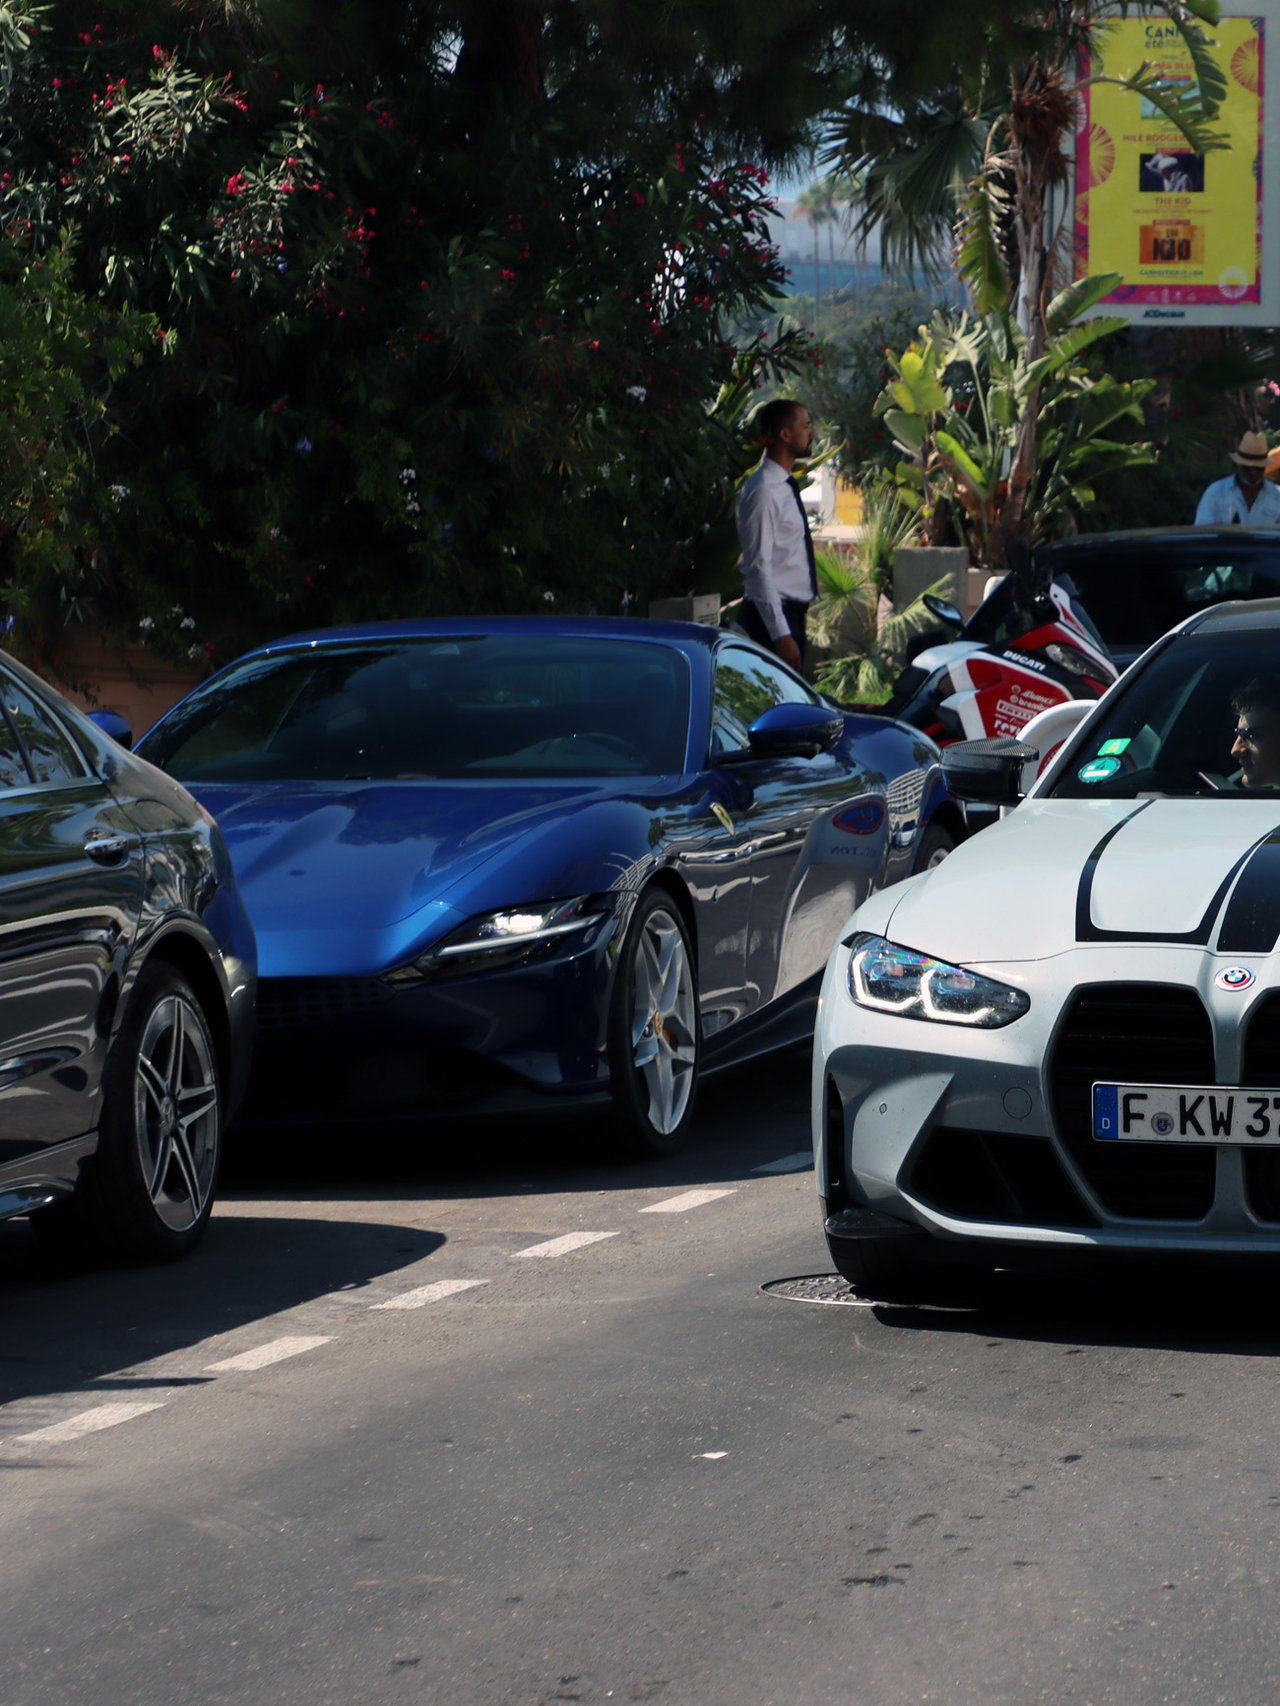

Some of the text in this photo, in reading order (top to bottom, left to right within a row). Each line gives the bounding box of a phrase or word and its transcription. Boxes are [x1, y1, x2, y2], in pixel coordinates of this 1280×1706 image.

[1146, 133, 1187, 142] RODGER
[1155, 197, 1191, 205] THE KID
[1143, 310, 1185, 318] JCDecaux
[1003, 650, 1046, 672] DUCATI
[1122, 1093, 1148, 1133] F
[1179, 1094, 1235, 1136] KW
[1102, 1117, 1111, 1130] D
